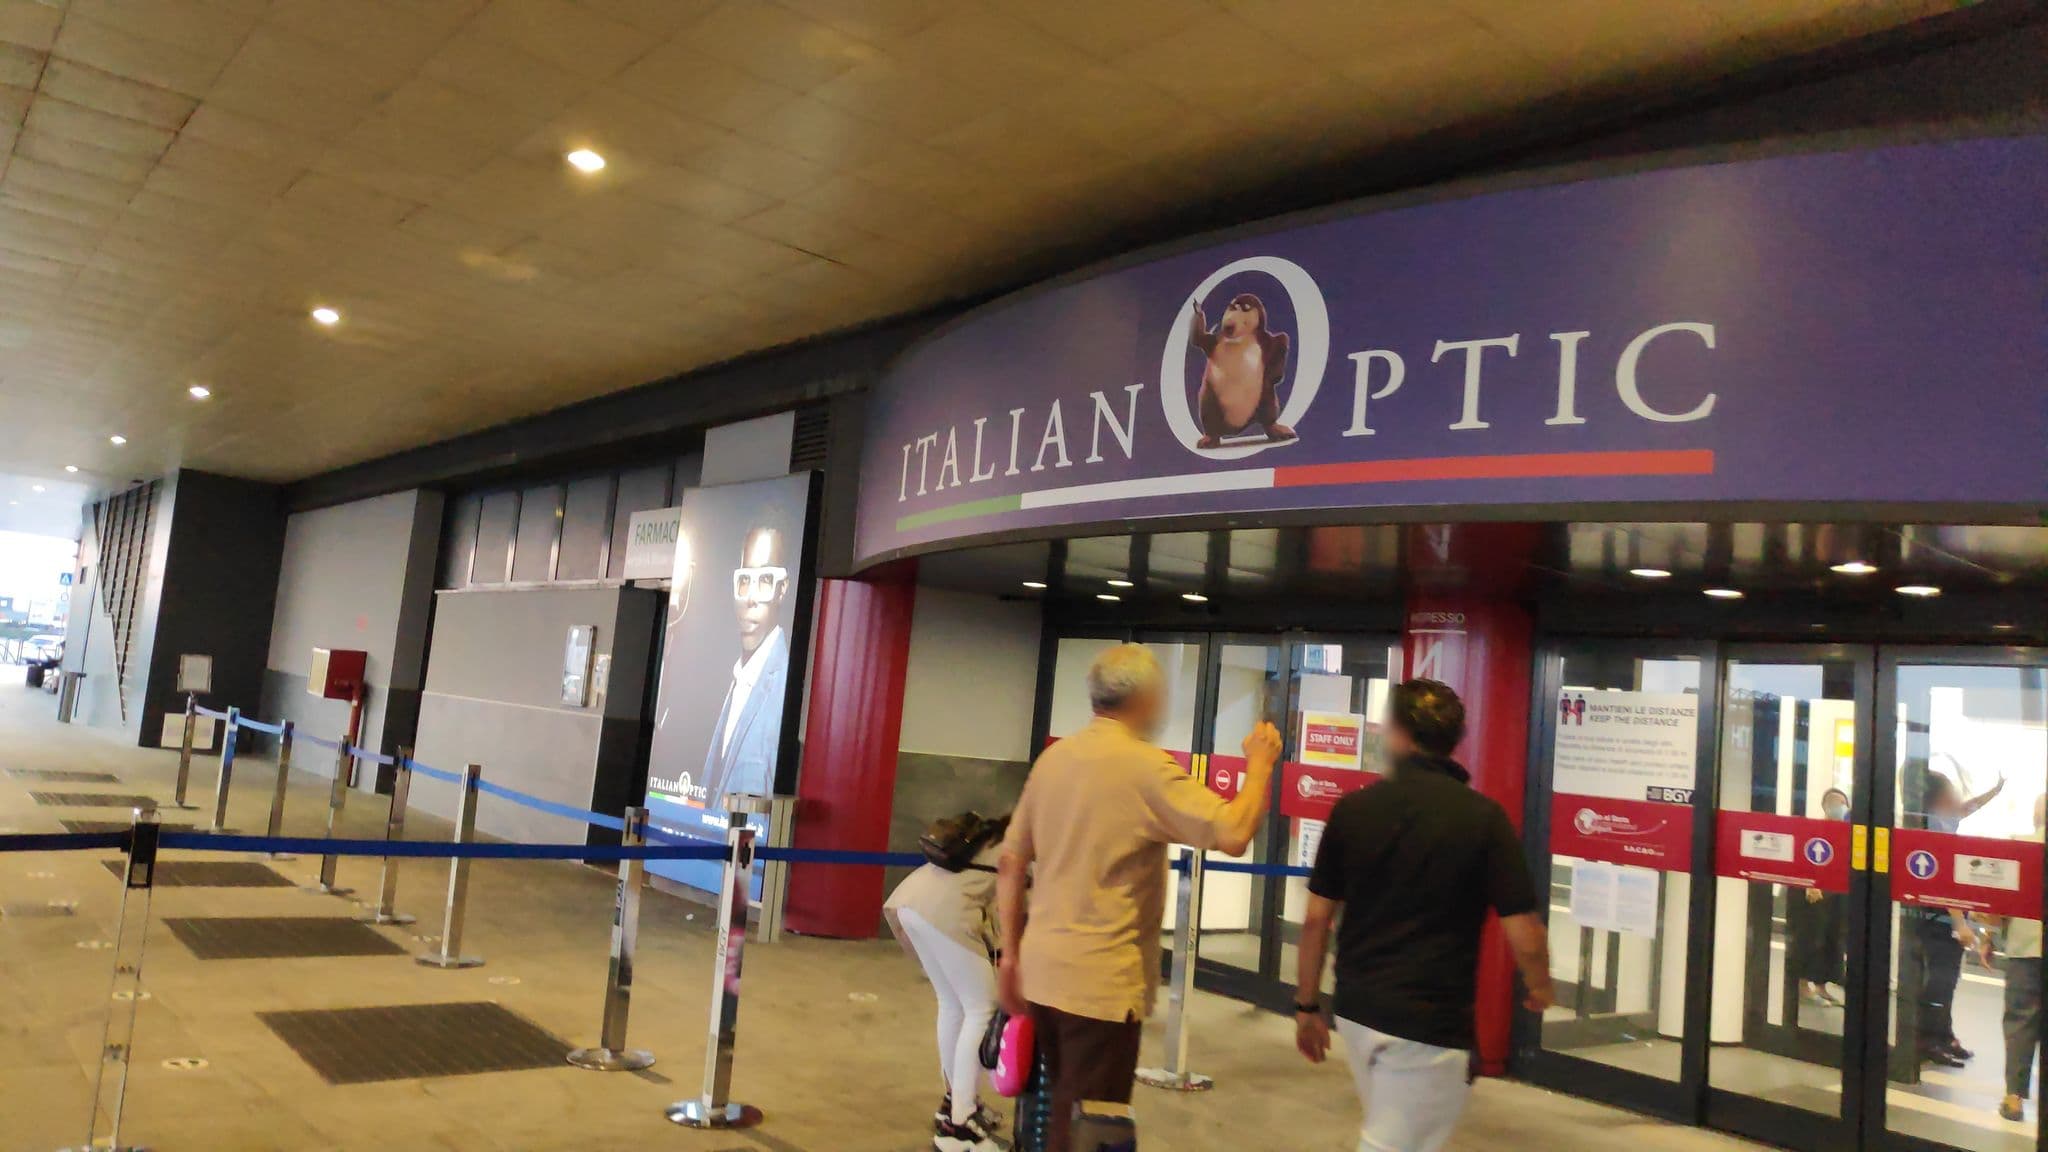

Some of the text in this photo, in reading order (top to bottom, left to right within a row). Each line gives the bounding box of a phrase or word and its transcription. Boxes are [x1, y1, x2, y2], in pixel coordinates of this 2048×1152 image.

[898, 383, 1144, 502] ITALIAN
[1635, 705, 1646, 715] LE
[1648, 707, 1696, 718] DISTANZE
[1589, 715, 1679, 727] KEEP THE DISTANCE
[1310, 733, 1354, 746] STAFF ONLY
[650, 776, 678, 792] ITALIAN
[1663, 788, 1692, 803] BGY
